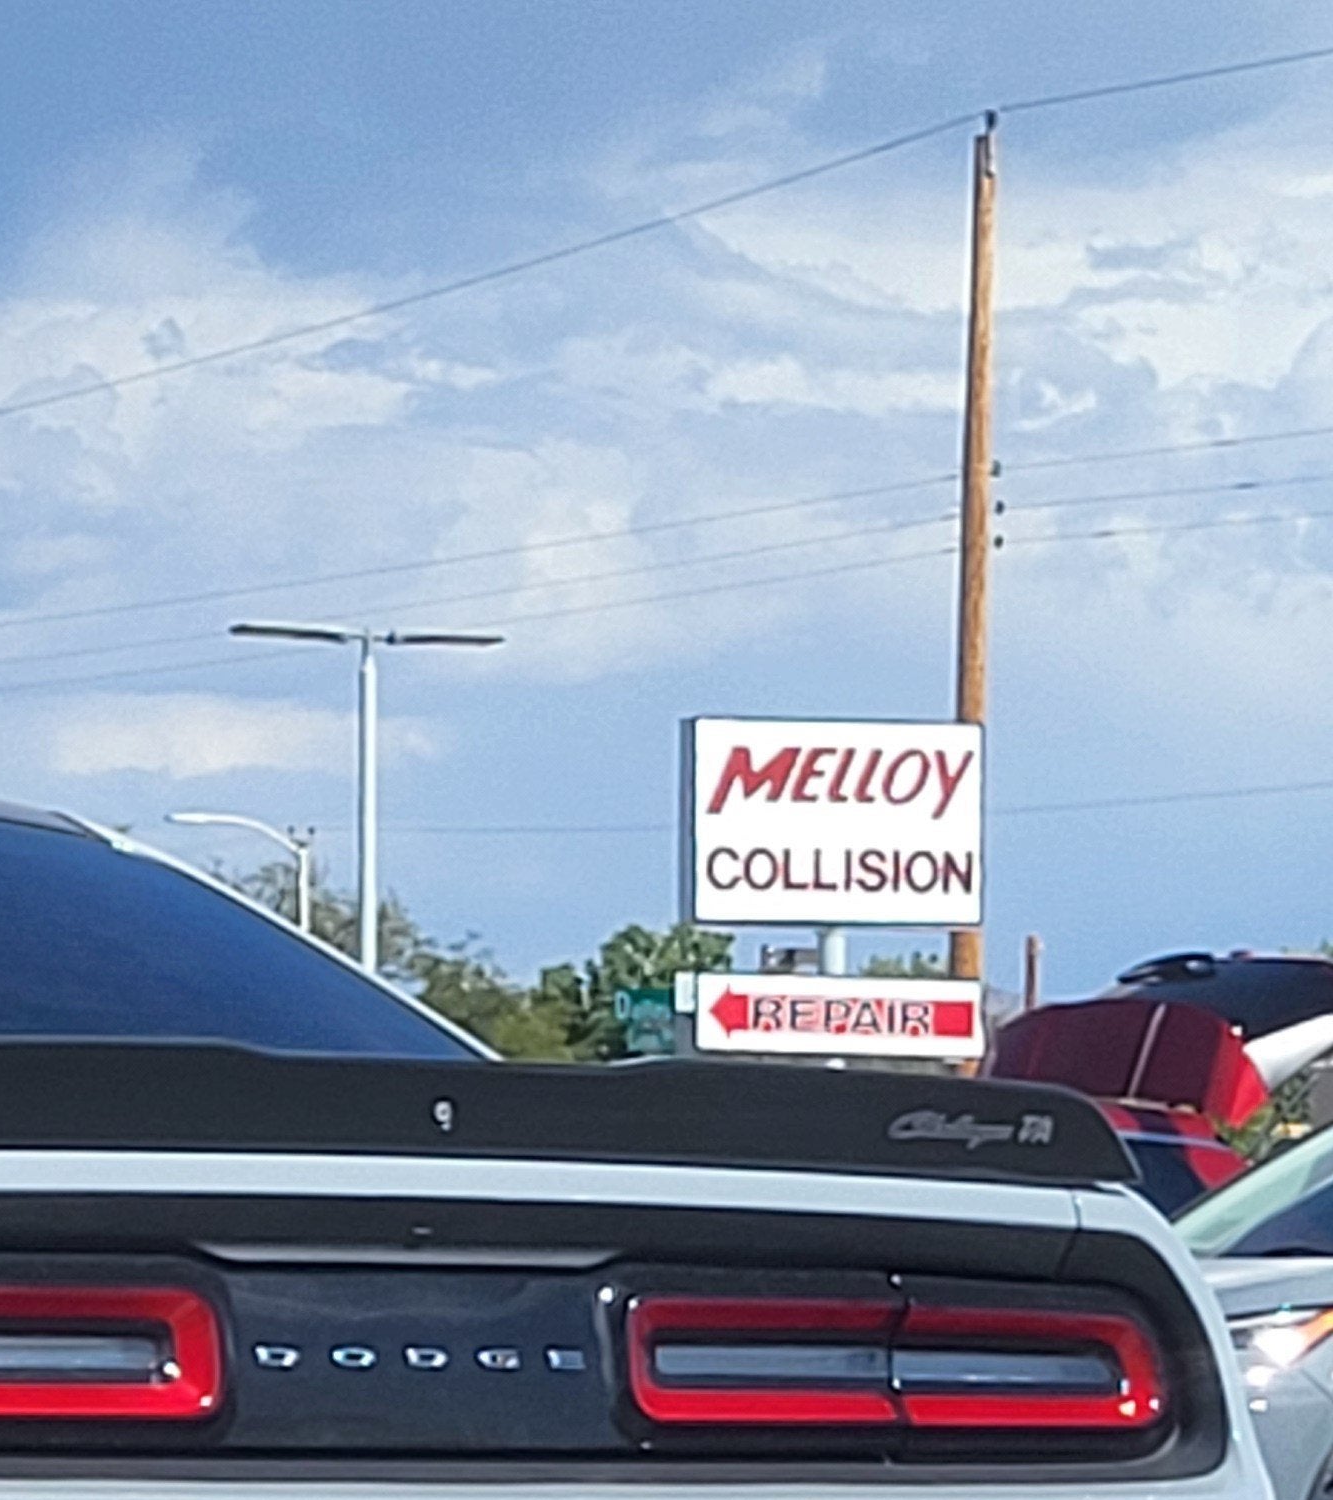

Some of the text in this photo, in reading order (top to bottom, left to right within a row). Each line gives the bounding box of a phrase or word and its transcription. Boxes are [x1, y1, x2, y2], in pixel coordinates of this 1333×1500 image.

[706, 745, 975, 820] MELLOY
[706, 846, 973, 895] COLLISION
[751, 998, 931, 1035] REPAIR
[253, 1343, 587, 1371] DODGE
